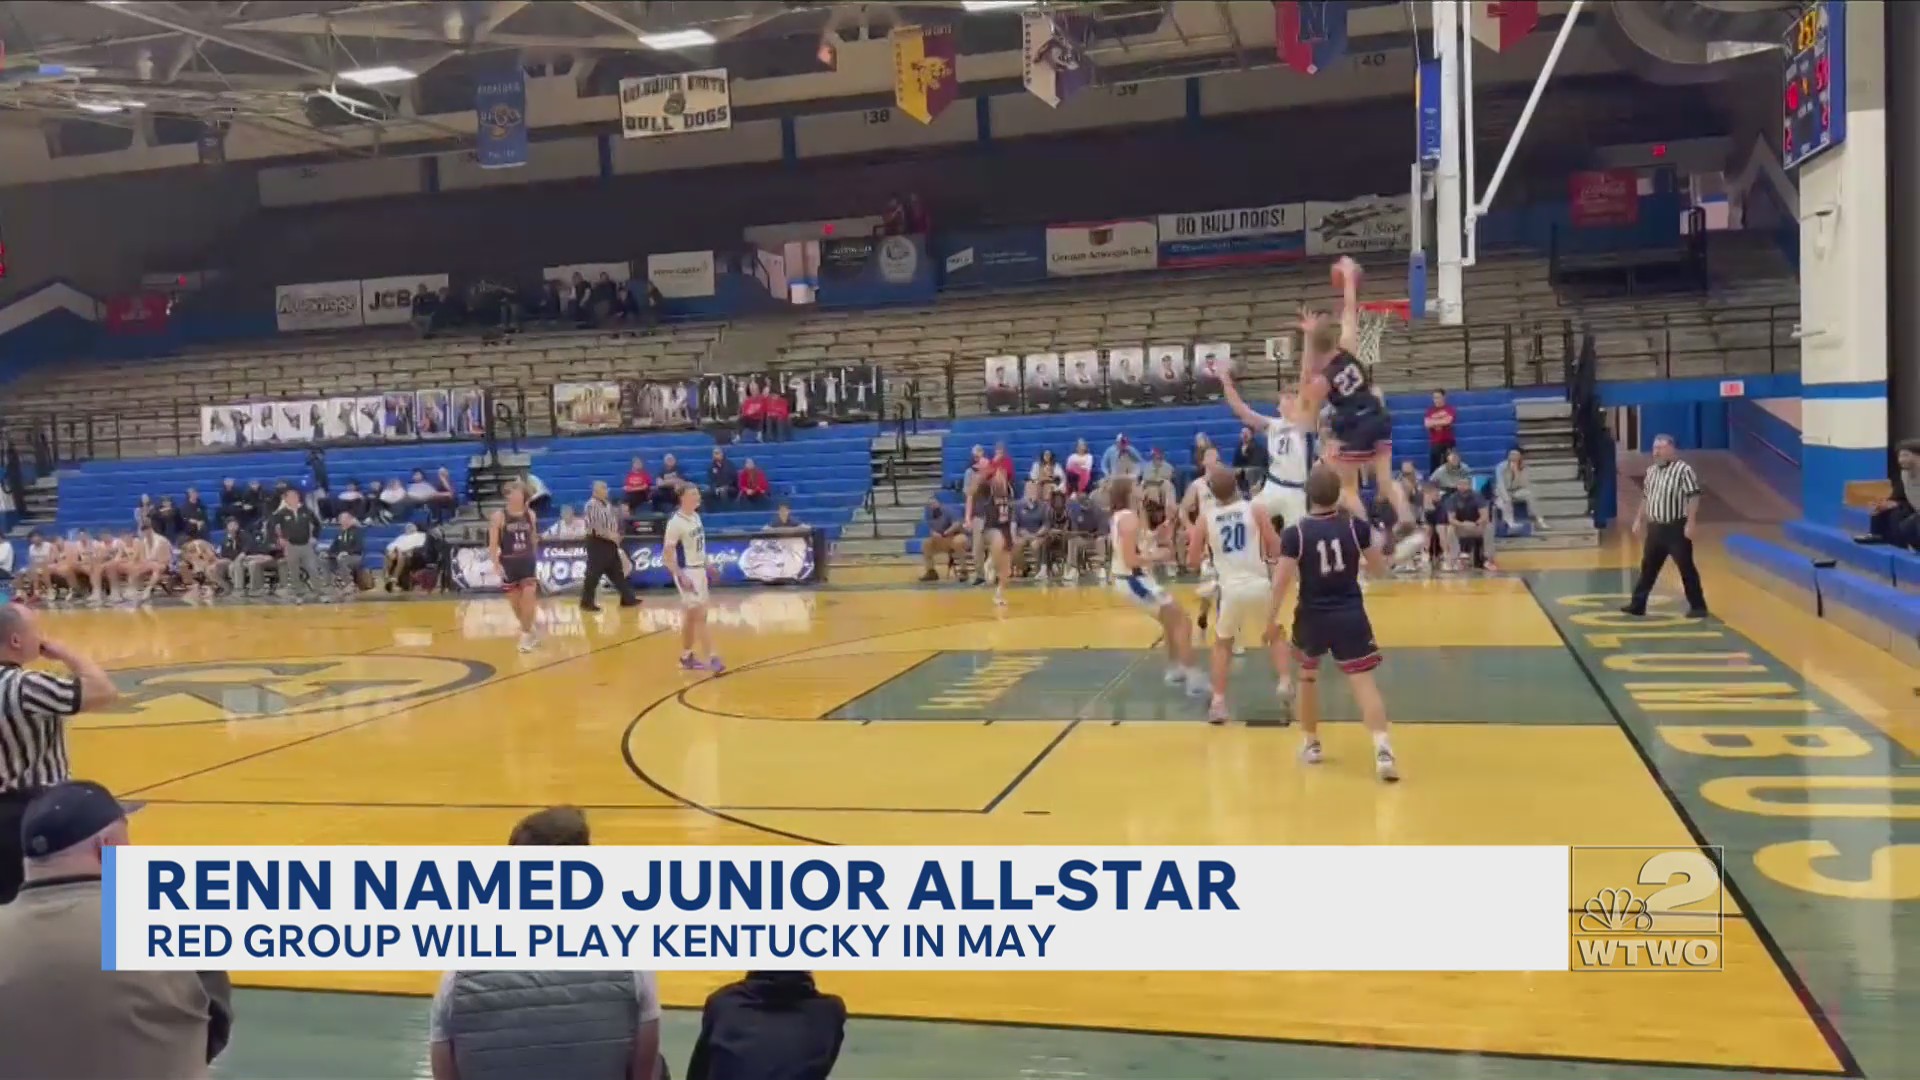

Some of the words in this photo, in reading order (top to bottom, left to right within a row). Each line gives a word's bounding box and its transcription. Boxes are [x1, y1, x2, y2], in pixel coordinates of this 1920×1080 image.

[683, 105, 728, 129] DOGS
[368, 288, 411, 312] JCB
[1333, 362, 1365, 398] 23
[1220, 522, 1247, 554] 20
[1315, 537, 1346, 577] 11
